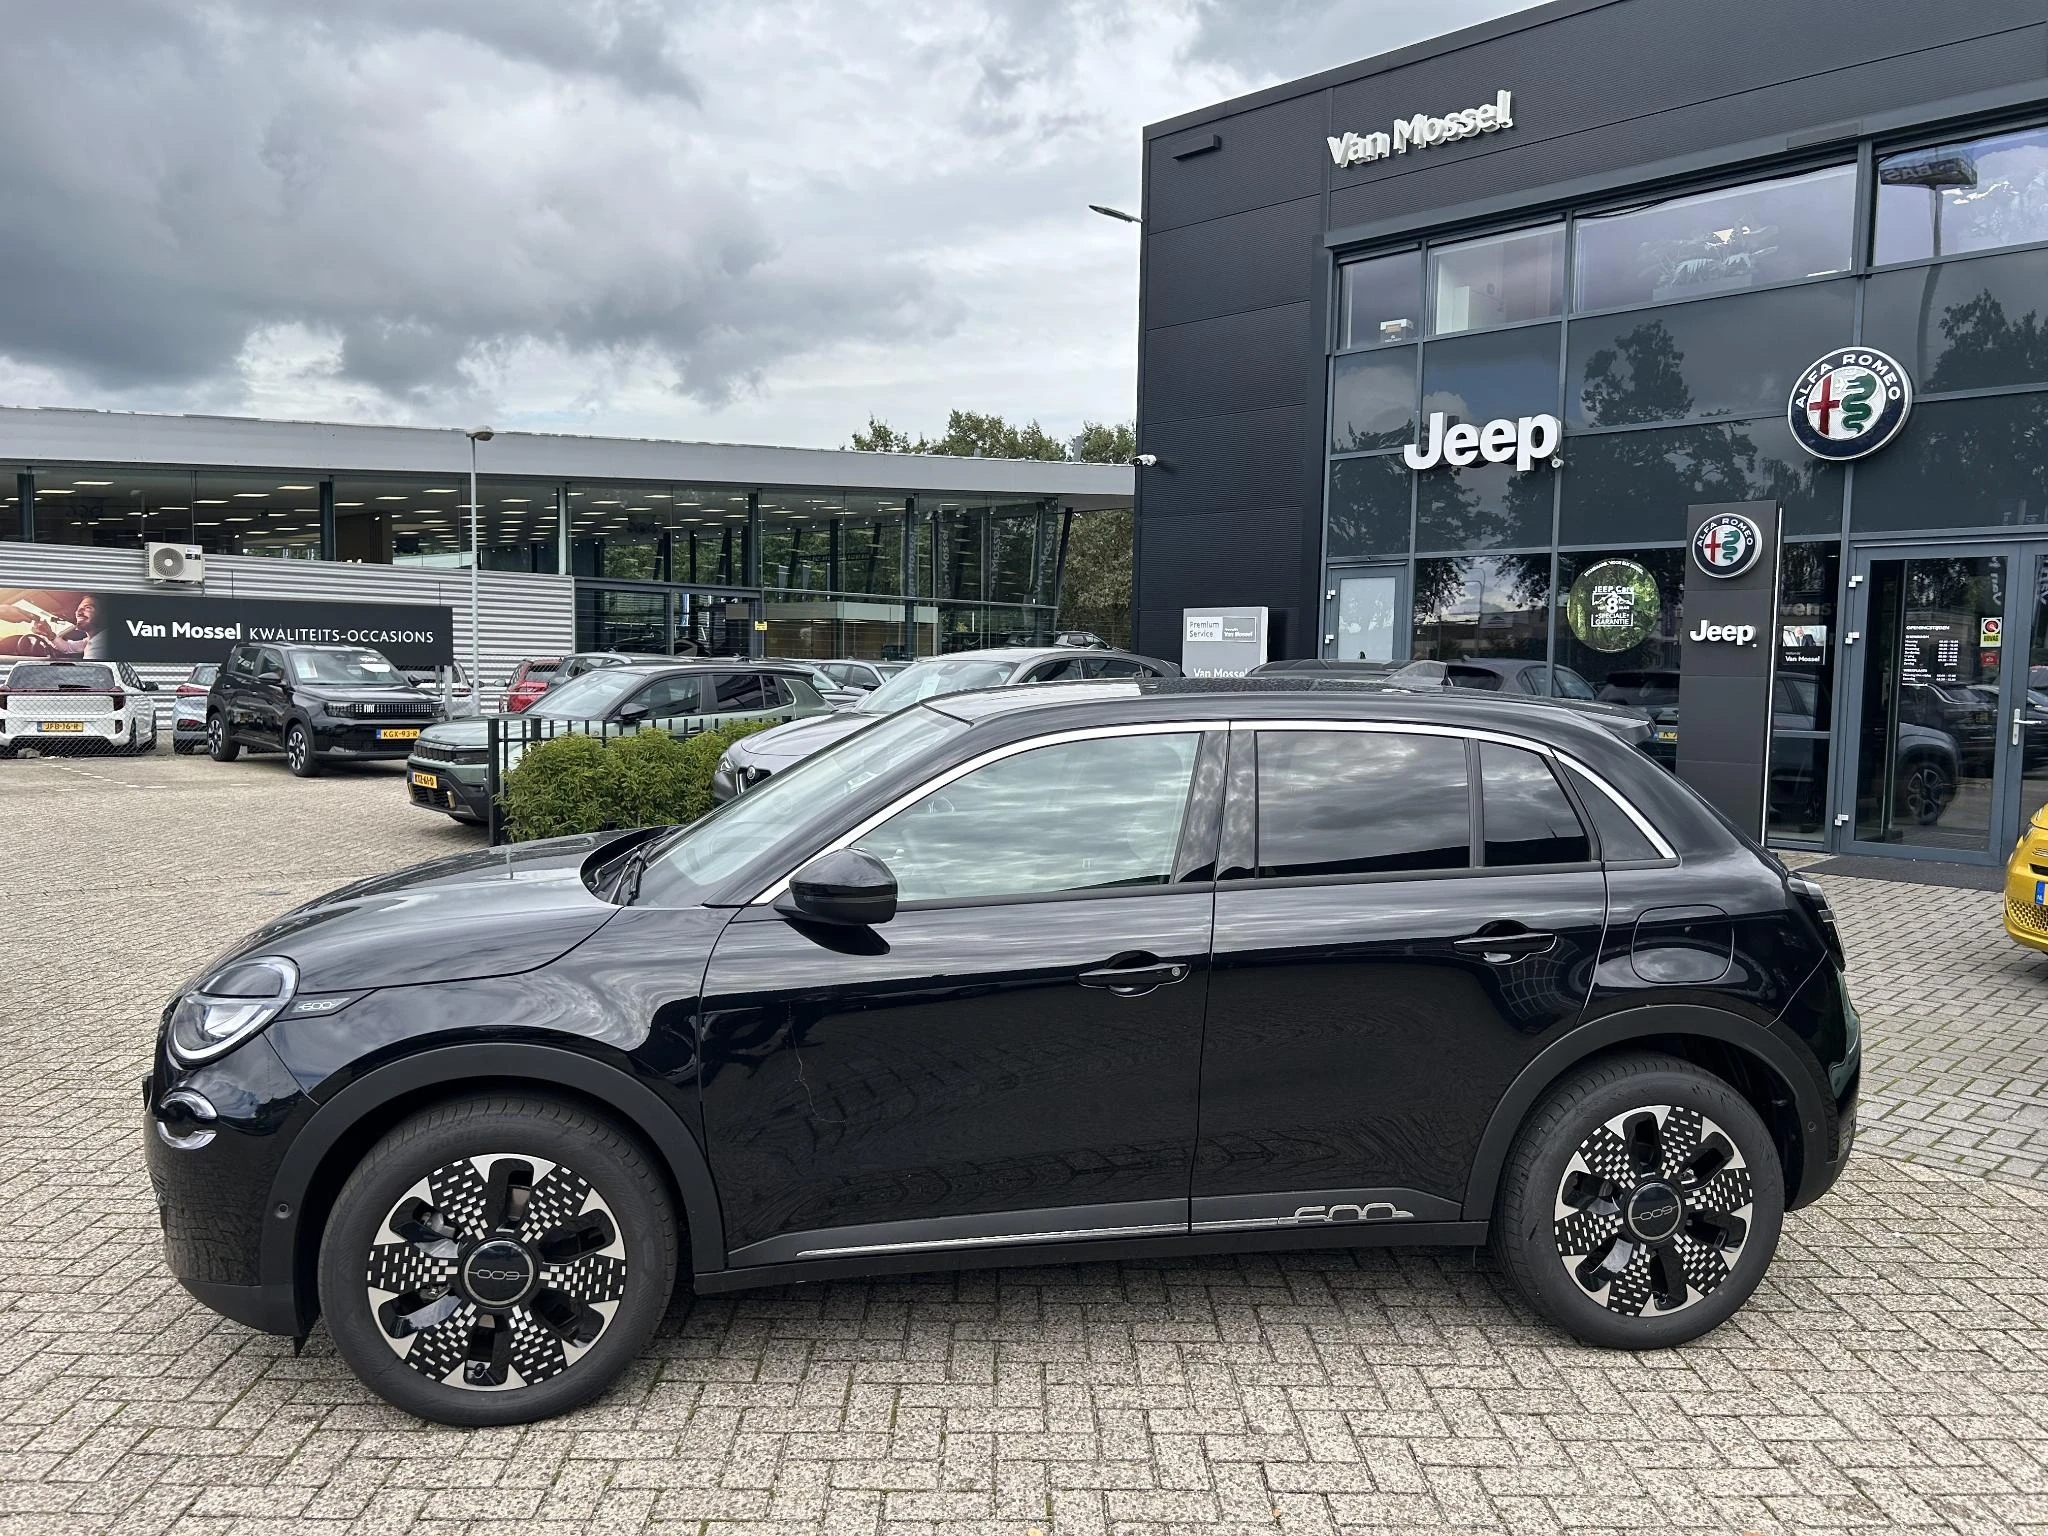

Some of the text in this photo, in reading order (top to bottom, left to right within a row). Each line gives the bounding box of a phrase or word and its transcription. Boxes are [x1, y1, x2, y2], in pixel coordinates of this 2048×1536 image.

[1327, 90, 1513, 168] Van Mossel
[1796, 354, 1901, 409] ALFA ROMEO
[1403, 411, 1560, 472] Jeep
[1039, 521, 1056, 568] Mossel
[1696, 517, 1754, 547] ALFA ROMEO
[942, 529, 950, 572] Mossel
[991, 527, 1001, 572] Mossel
[1607, 597, 1619, 614] 8
[126, 620, 434, 643] Van Mossel KWALITEITS-OCCASIONS
[1189, 621, 1220, 629] Premium
[1189, 630, 1214, 638] Service
[1689, 619, 1756, 646] Jeep
[1193, 668, 1211, 678] Van
[383, 730, 418, 738] KGX-93-R
